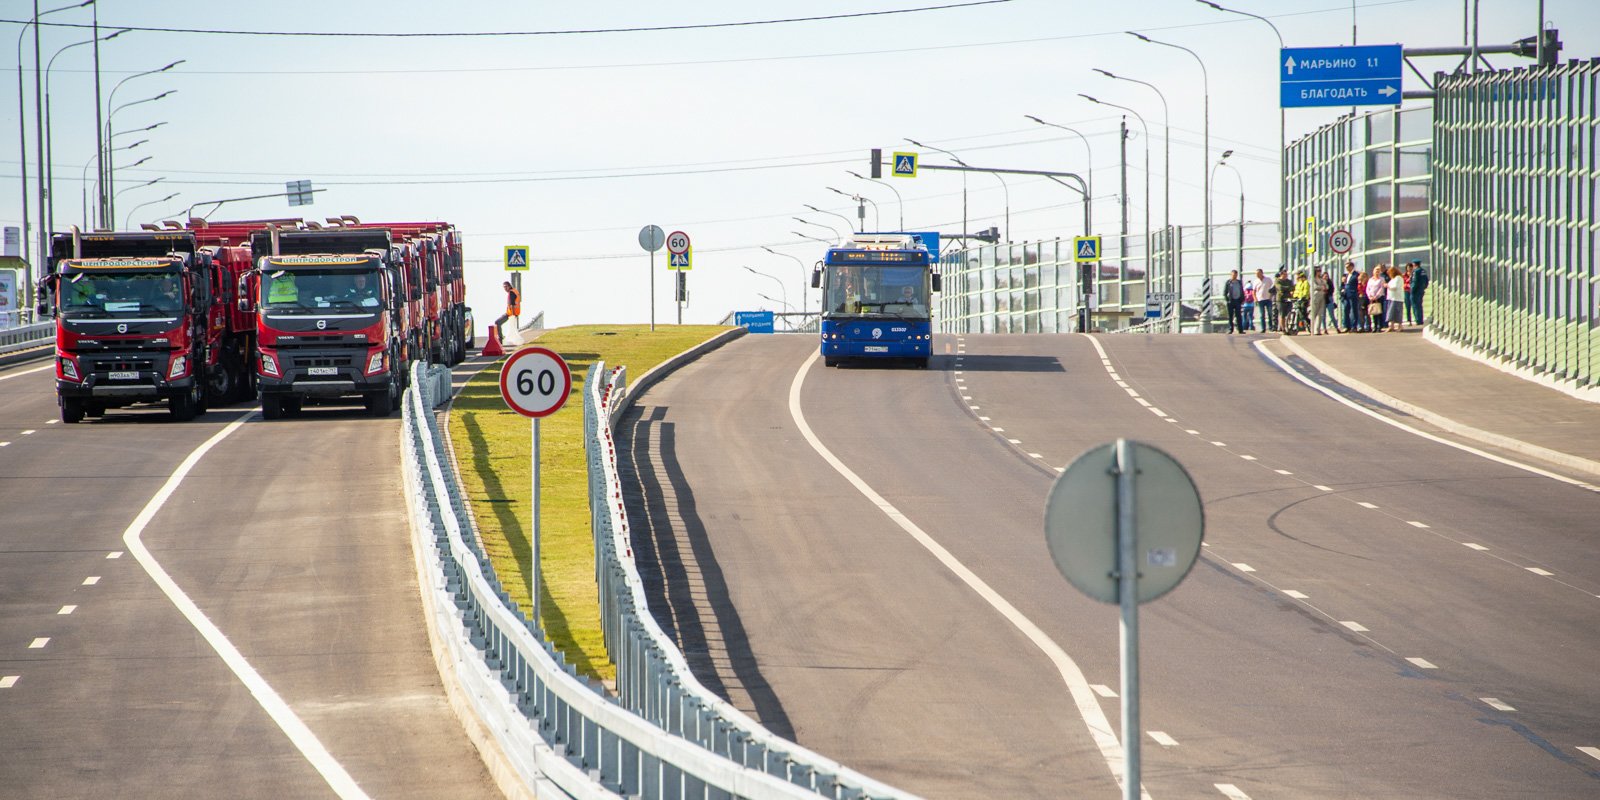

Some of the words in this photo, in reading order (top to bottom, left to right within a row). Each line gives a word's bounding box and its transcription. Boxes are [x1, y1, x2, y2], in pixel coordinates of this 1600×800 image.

[1300, 58, 1357, 69] МАРЬИНО
[1367, 57, 1379, 67] 1.1
[1301, 87, 1368, 99] БЛАГОДАТЬ
[671, 238, 686, 248] 60
[1334, 237, 1348, 247] 60
[516, 369, 555, 396] 60
